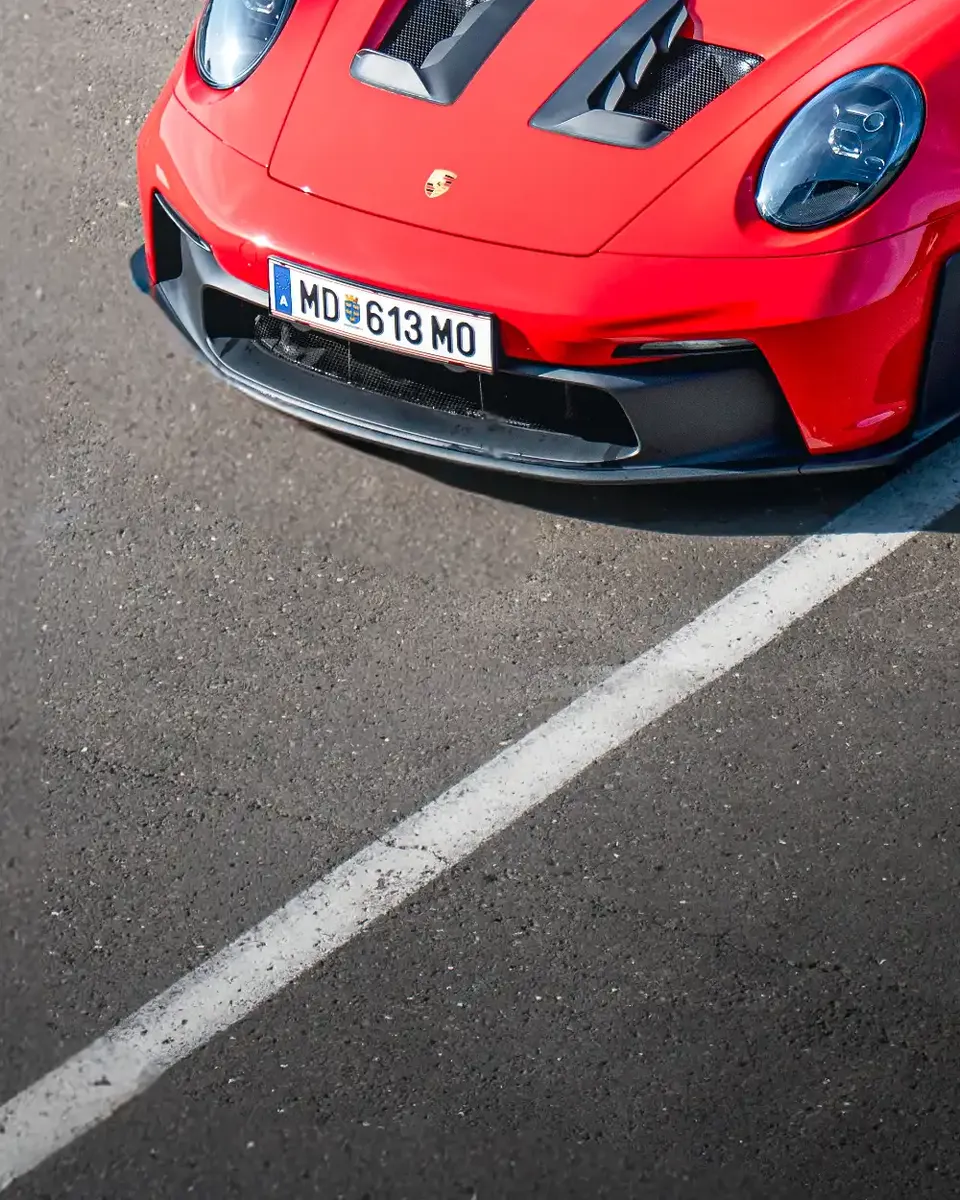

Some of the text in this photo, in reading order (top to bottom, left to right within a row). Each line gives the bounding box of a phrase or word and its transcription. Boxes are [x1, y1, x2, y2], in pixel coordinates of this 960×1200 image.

[279, 295, 288, 307] A
[299, 279, 476, 357] MD 613 MO
